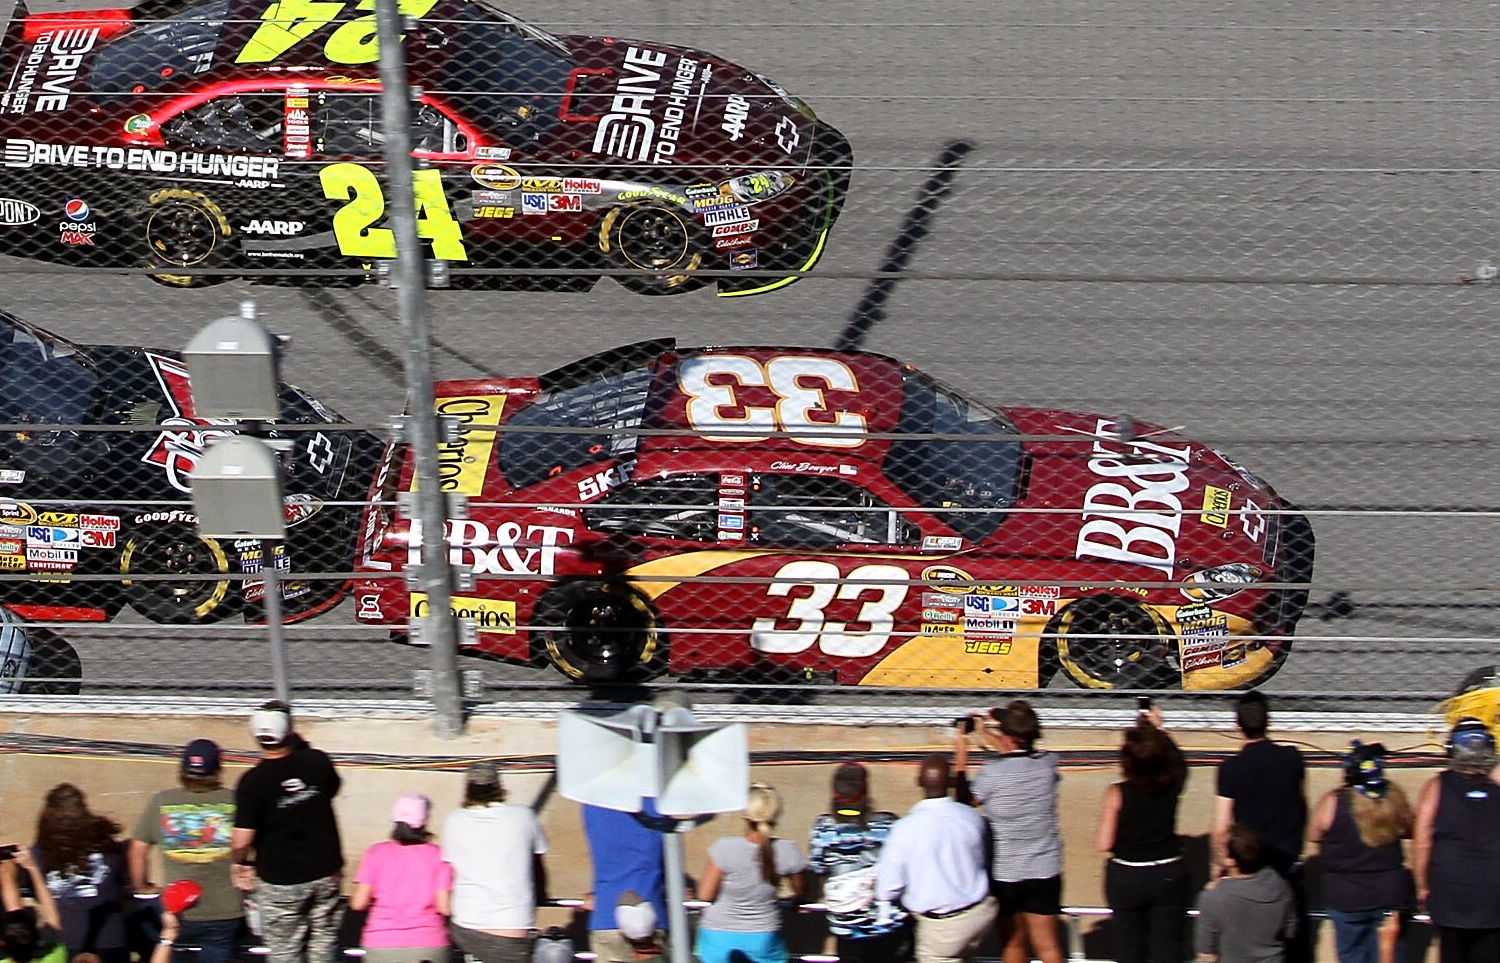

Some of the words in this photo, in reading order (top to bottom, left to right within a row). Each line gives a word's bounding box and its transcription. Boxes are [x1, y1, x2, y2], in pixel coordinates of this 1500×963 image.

[27, 44, 51, 66] END
[668, 56, 700, 107] HUNGER
[10, 65, 43, 115] HUNGER
[592, 46, 667, 162] DRIVE
[660, 107, 684, 141] END
[721, 94, 750, 142] AARP
[5, 138, 88, 169] DRIVE
[93, 148, 125, 169] TO
[127, 150, 177, 173] END
[178, 154, 280, 179] HUNGER
[653, 140, 676, 164] TO
[236, 179, 270, 189] AARP
[564, 179, 601, 193] Holley
[750, 177, 770, 194] 24
[523, 194, 546, 210] USG
[550, 195, 581, 211] 3M
[693, 195, 734, 208] MOOG
[318, 162, 469, 261] 24
[473, 206, 516, 219] JEGS
[705, 208, 749, 224] MAHLE
[60, 221, 97, 234] pepsi
[240, 220, 306, 236] AARP
[715, 223, 748, 236] COMP
[61, 231, 95, 246] MAX
[678, 355, 868, 448] 33
[770, 460, 797, 471] Clint
[796, 462, 838, 474] Bowyer
[577, 459, 638, 502] SKF
[1, 508, 20, 517] Sprint
[80, 515, 119, 527] Holley
[27, 526, 51, 543] USG
[82, 530, 115, 547] 3M
[29, 549, 61, 560] Mobil
[241, 545, 285, 561] MOG
[29, 561, 73, 569] CRAFTSMAN
[750, 561, 911, 657] 33
[966, 595, 990, 612] USG
[1022, 598, 1056, 616] 3M
[932, 625, 956, 633] Auto
[966, 618, 1000, 630] Mobil
[1183, 615, 1227, 631] MOOG
[964, 641, 1013, 655] JEGS
